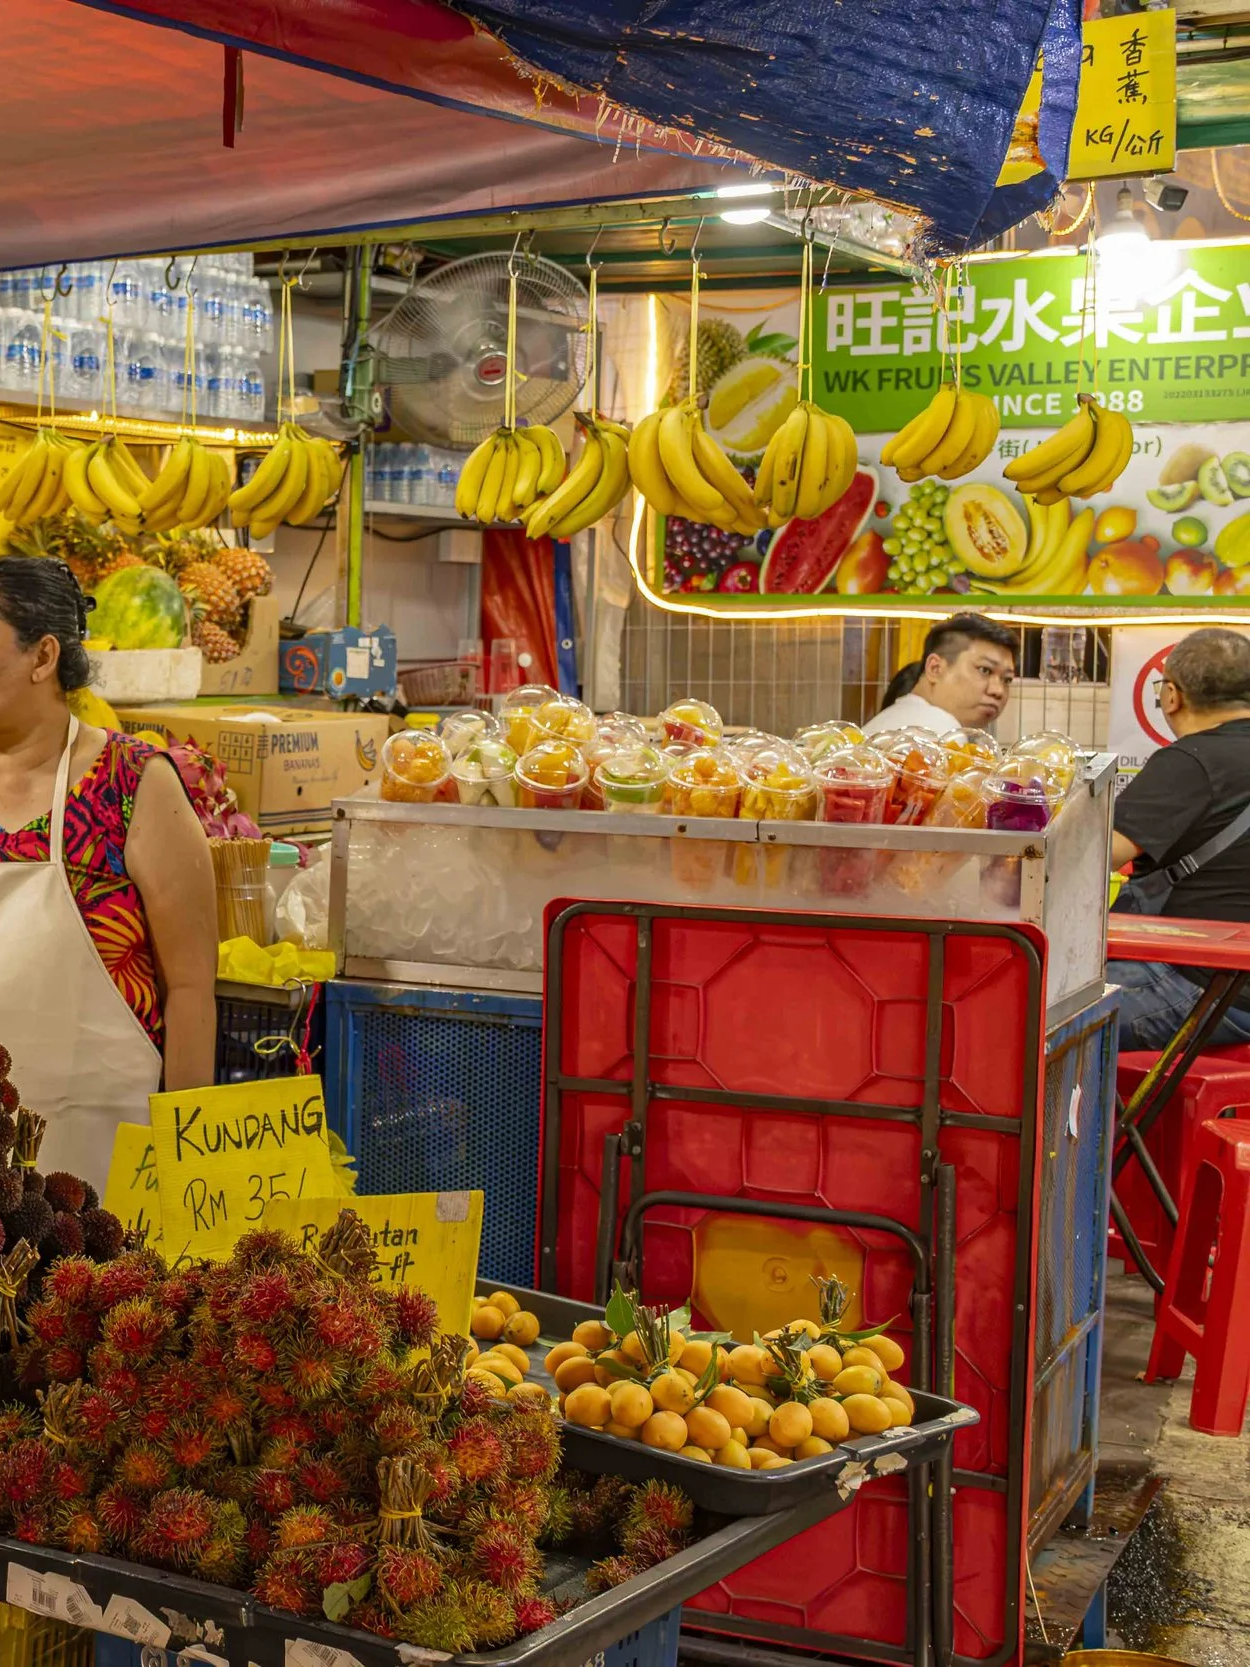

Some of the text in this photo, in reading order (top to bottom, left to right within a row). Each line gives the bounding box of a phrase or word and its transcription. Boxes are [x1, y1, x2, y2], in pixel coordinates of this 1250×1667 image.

[1116, 28, 1150, 105] 香蕉
[827, 267, 1250, 356] 旺記水果企
[823, 369, 870, 393] WK
[987, 359, 1101, 387] VALLEY
[993, 392, 1063, 417] INCE
[271, 732, 320, 754] PREMIUM
[174, 1095, 327, 1162] KUNDANG
